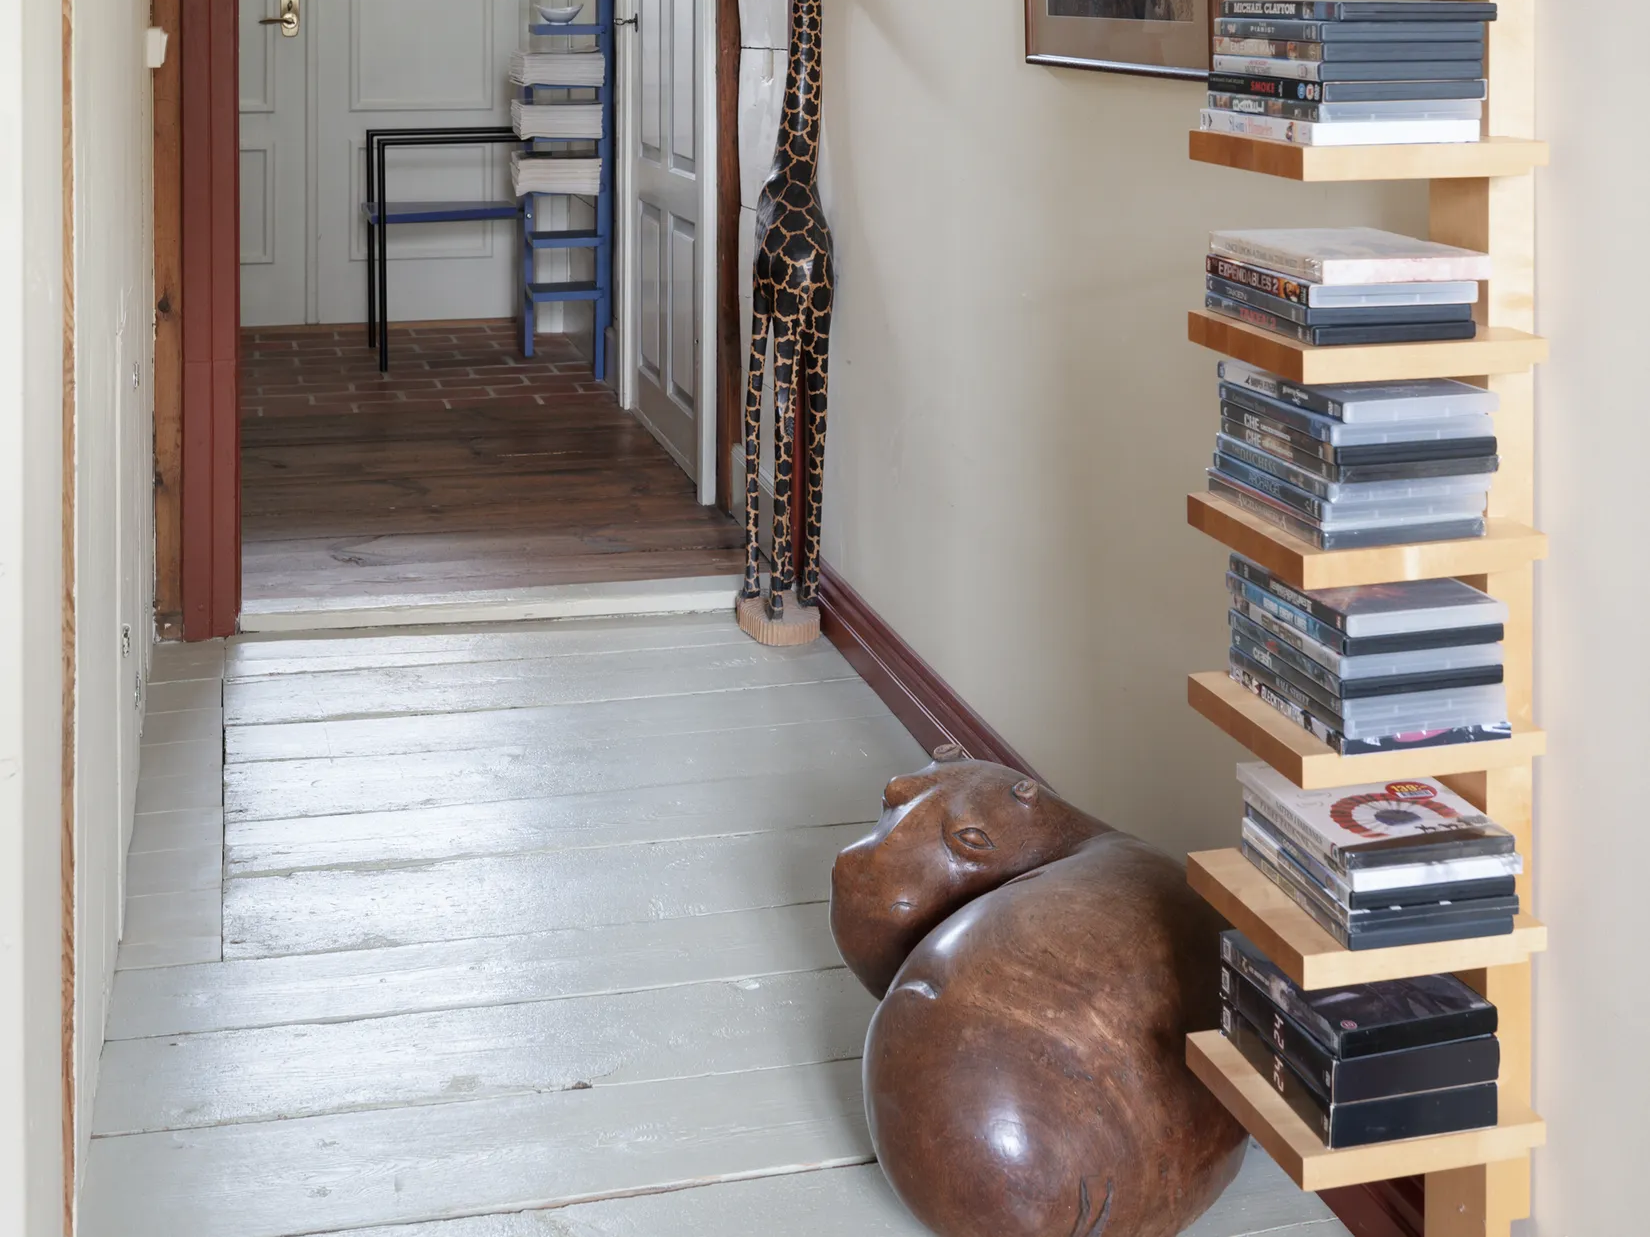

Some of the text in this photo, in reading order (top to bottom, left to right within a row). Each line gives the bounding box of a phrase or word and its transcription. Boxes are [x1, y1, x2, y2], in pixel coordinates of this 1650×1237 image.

[1233, 2, 1296, 15] MICHAEL CLAYTON
[1250, 26, 1275, 34] PIANIST
[1250, 80, 1275, 94] SMOKE
[1218, 261, 1272, 290] EXPENDABLES
[1272, 277, 1279, 293] 2
[1225, 286, 1248, 301] TAKEN
[1240, 307, 1277, 330] TAKEN 2
[1244, 413, 1260, 431] CHE
[1246, 429, 1261, 448] CHE
[1239, 449, 1277, 475] DUCHESS
[1252, 646, 1272, 669] crash
[1273, 1013, 1284, 1050] 24
[1273, 1055, 1284, 1093] 24
